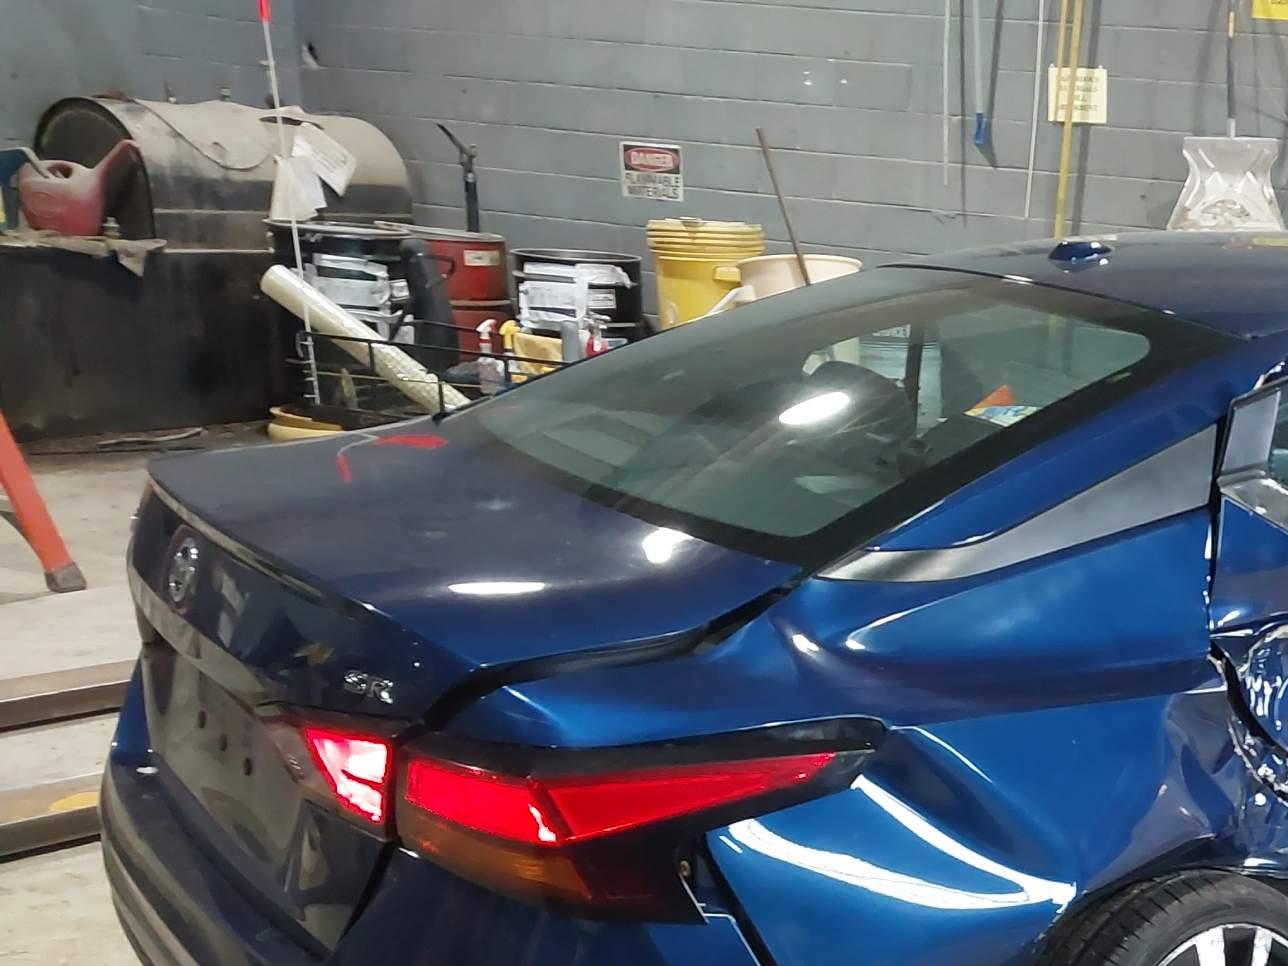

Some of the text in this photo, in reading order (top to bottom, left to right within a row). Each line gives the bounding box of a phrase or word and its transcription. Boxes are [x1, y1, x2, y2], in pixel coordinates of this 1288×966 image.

[630, 151, 673, 168] DANGER
[625, 172, 680, 187] FLAMMABLE
[627, 185, 679, 199] MATERIALS
[343, 669, 394, 704] SR
